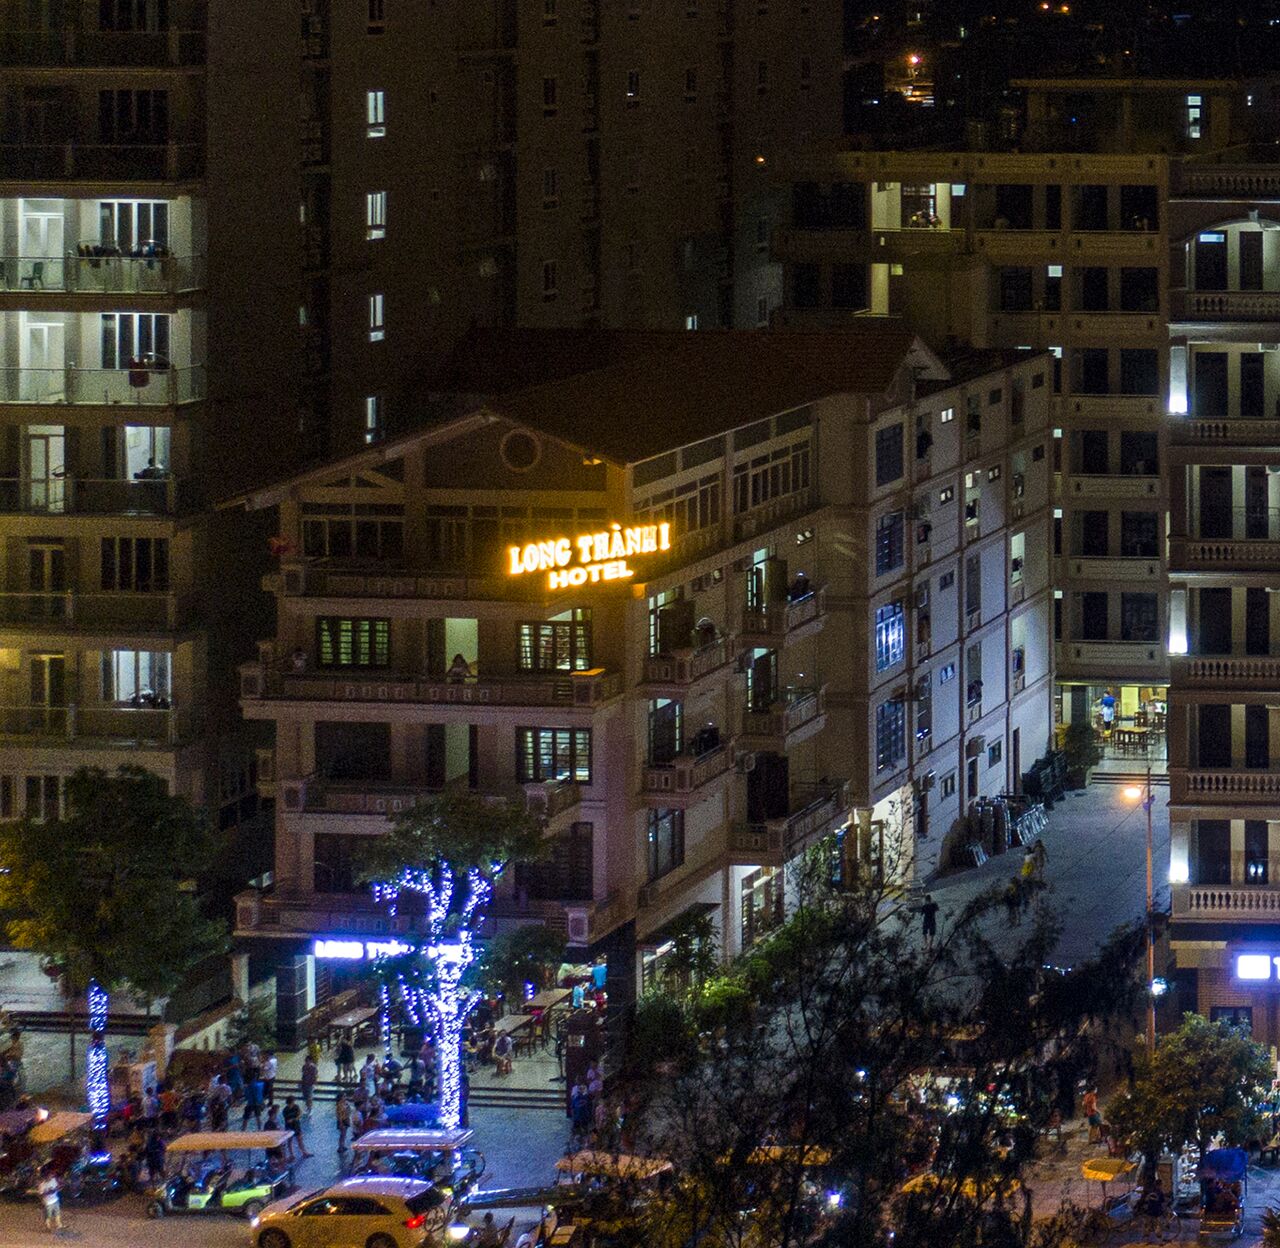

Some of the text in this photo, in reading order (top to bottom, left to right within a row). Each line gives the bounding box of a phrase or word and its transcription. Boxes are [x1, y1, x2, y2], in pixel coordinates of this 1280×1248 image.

[508, 537, 573, 576] LONG
[576, 521, 658, 564] THÀNH
[548, 559, 635, 590] HOTEL
